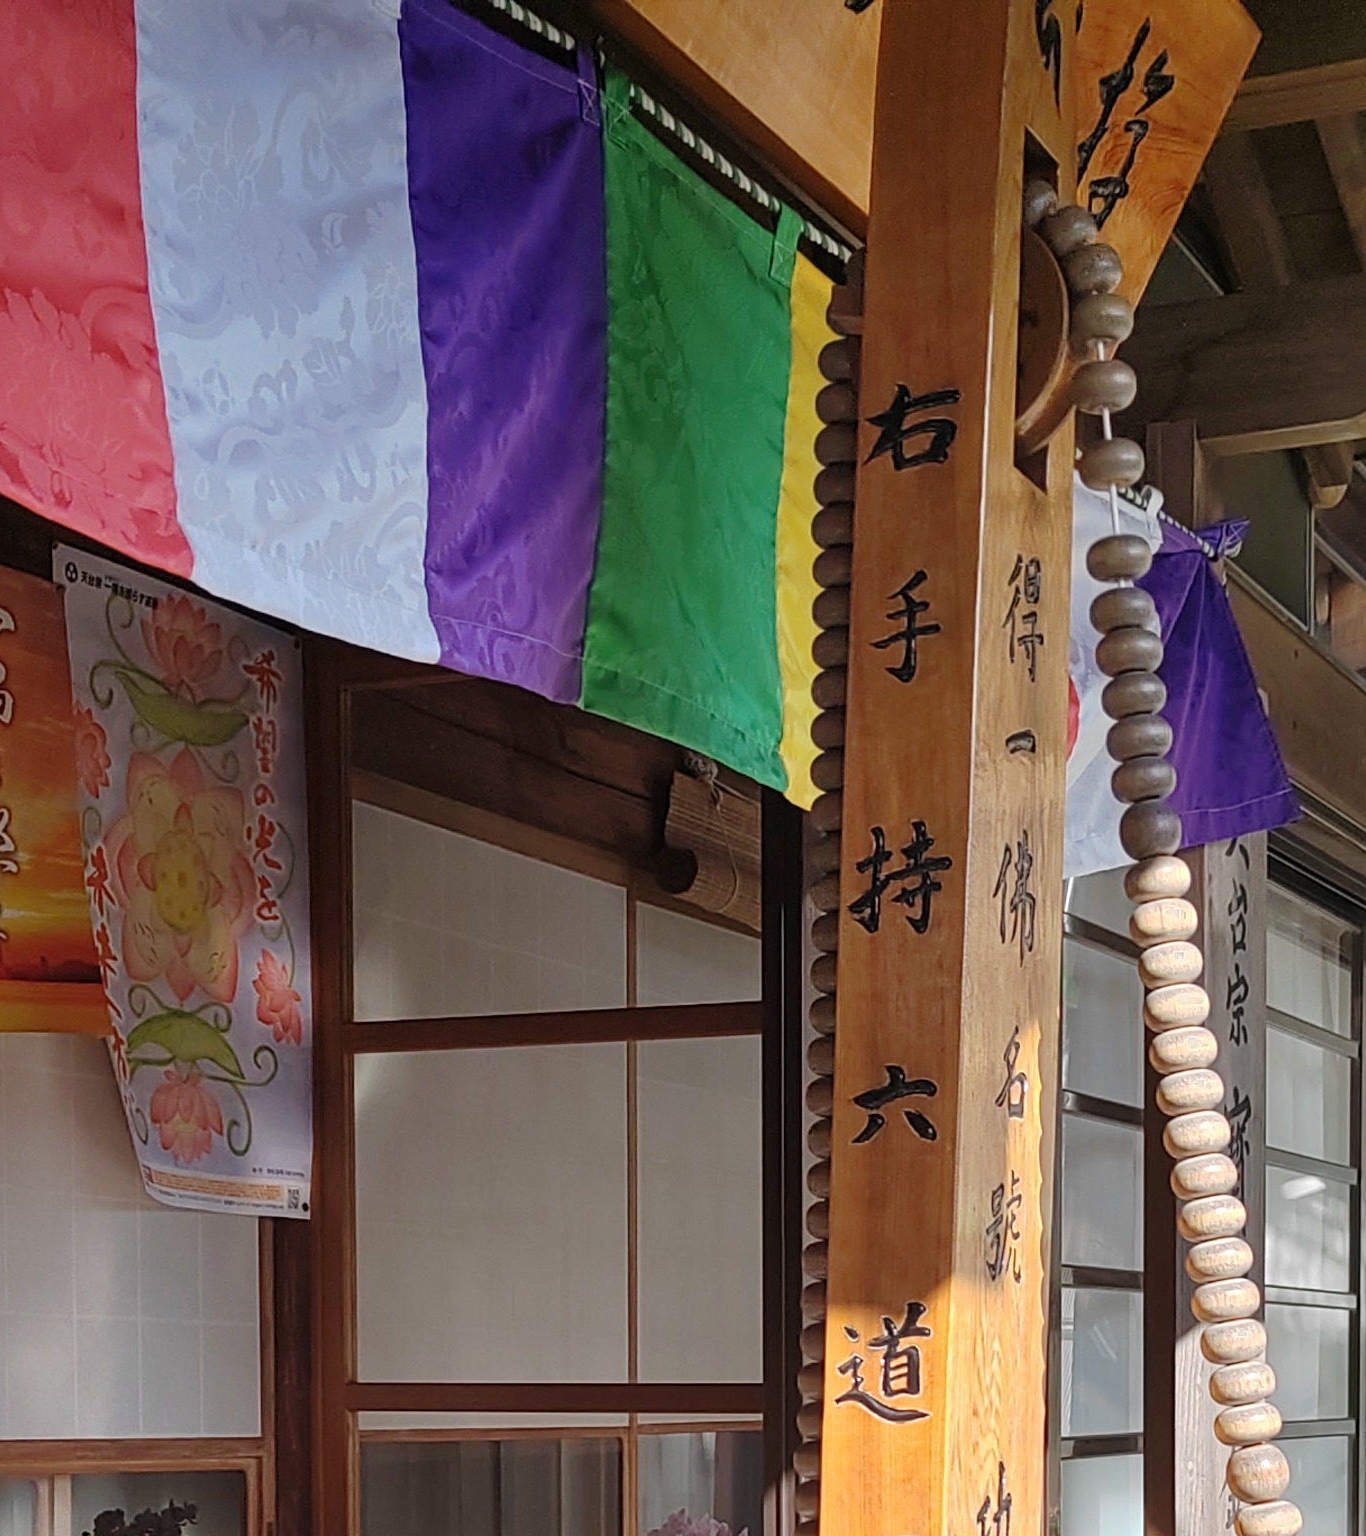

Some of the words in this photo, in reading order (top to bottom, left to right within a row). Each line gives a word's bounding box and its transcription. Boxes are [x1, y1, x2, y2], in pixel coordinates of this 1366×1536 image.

[242, 649, 283, 923] 希望の光を
